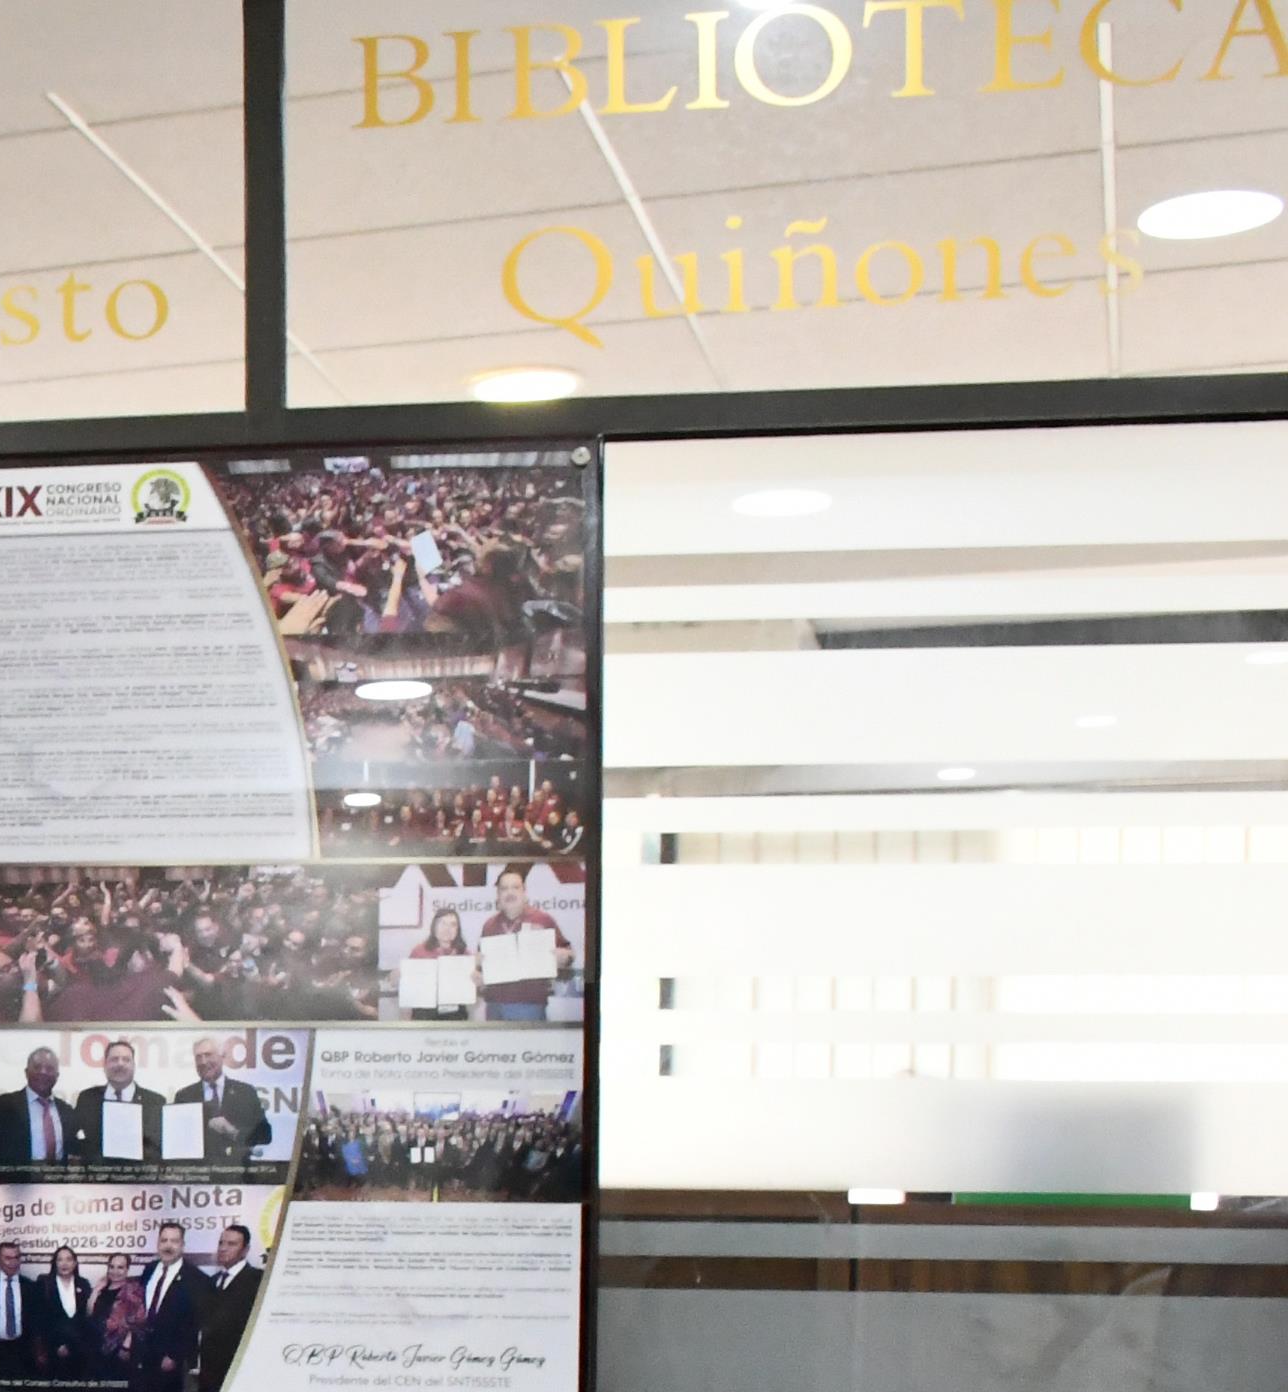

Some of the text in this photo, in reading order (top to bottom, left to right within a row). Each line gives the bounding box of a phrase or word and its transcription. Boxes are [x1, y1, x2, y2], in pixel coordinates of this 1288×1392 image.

[350, 0, 1288, 130] BIBLIOTECA
[500, 214, 1146, 350] Quiñones
[46, 481, 122, 495] CONGRESO
[46, 493, 121, 506] NACIONAL
[45, 504, 122, 518] ORDINARIO
[224, 1028, 296, 1071] de
[320, 1049, 576, 1064] QBP Roberto Javier Gómez Gómez
[30, 1198, 56, 1216] de
[62, 1195, 124, 1215] Toma
[131, 1190, 164, 1212] de
[171, 1186, 243, 1209] Nota
[52, 1220, 111, 1234] Nacional
[114, 1218, 138, 1233] del
[62, 1234, 148, 1249] 2026-2030
[309, 1373, 369, 1386] Presidente
[373, 1373, 392, 1387] del
[394, 1375, 422, 1387] CEN
[425, 1375, 444, 1387] del
